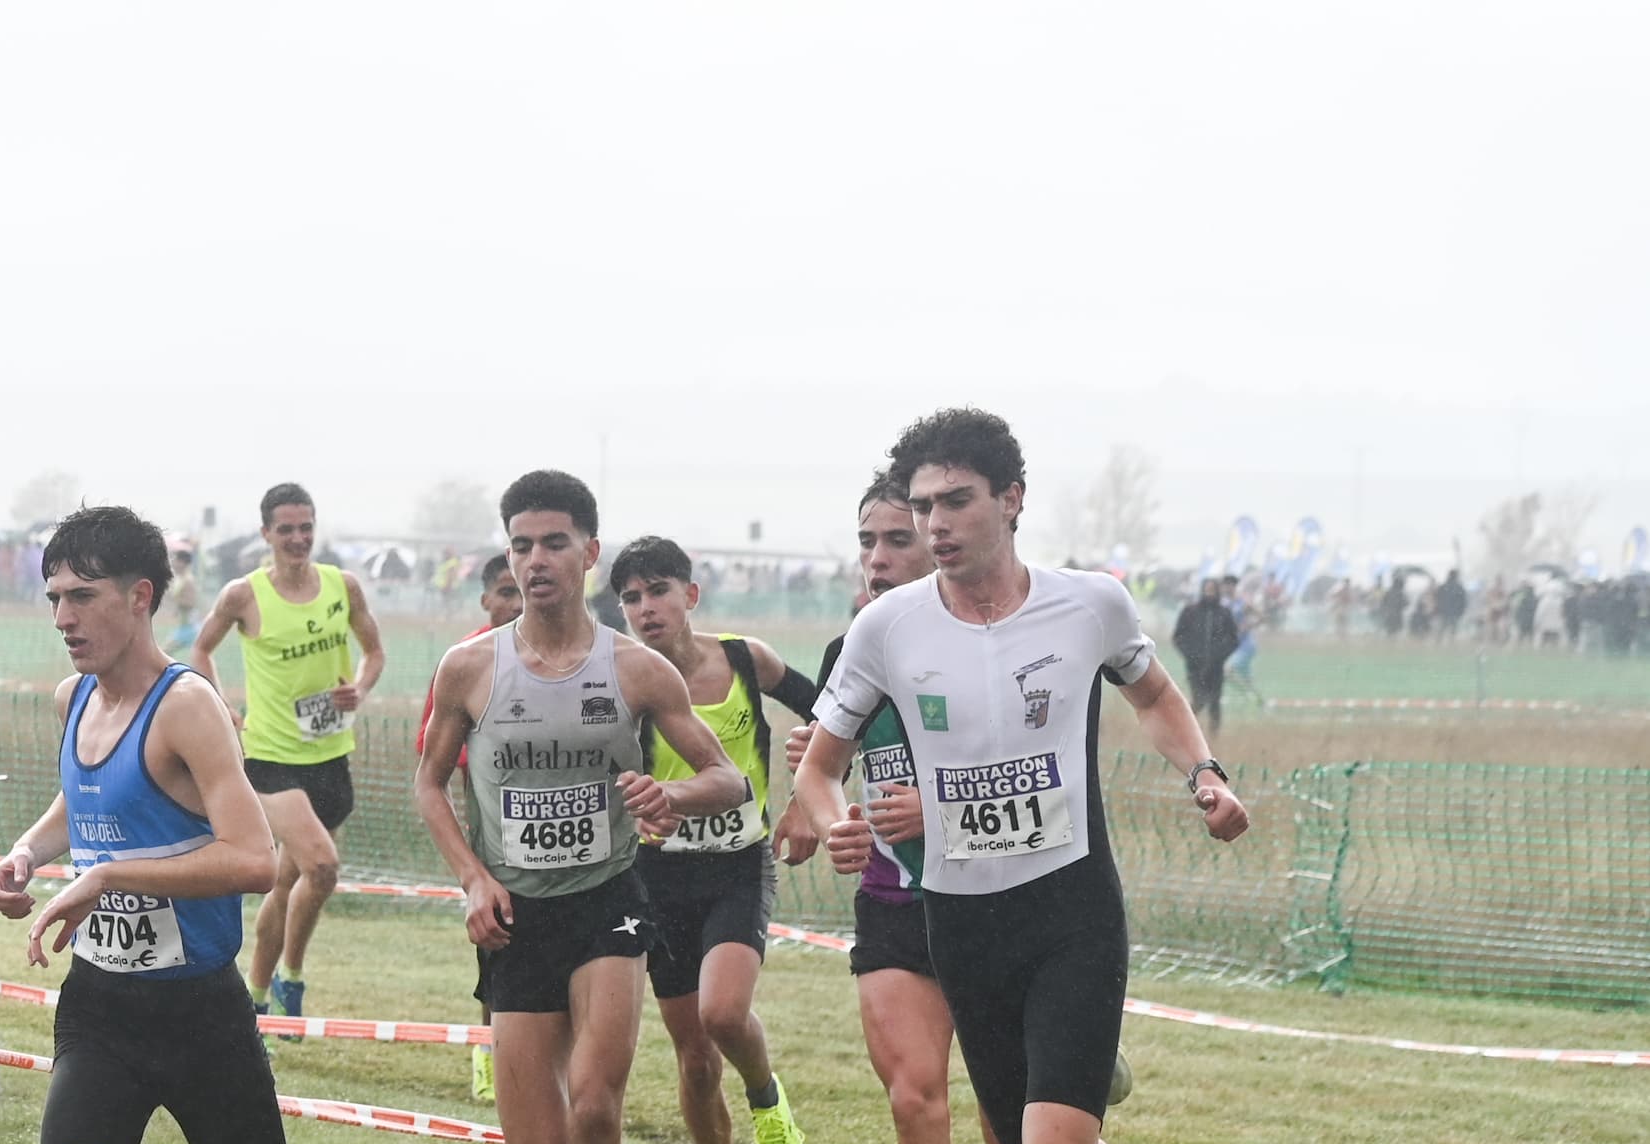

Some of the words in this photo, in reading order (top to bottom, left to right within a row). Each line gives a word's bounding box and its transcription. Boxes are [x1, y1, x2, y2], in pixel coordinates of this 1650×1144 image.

[493, 740, 604, 770] aldahra
[942, 755, 1048, 783] DIPUTACIÓN
[510, 785, 598, 804] DIPUTACIÓN
[944, 770, 1051, 800] BURGOS
[510, 797, 600, 818] BURGOS
[960, 795, 1042, 836] 4611
[520, 817, 594, 850] 4688
[677, 809, 744, 842] 4703
[524, 853, 567, 864] iberCaja
[967, 839, 1015, 851] iberCaja
[96, 894, 159, 912] RGOS
[89, 913, 157, 950] 4704
[92, 952, 128, 967] iberCaja
